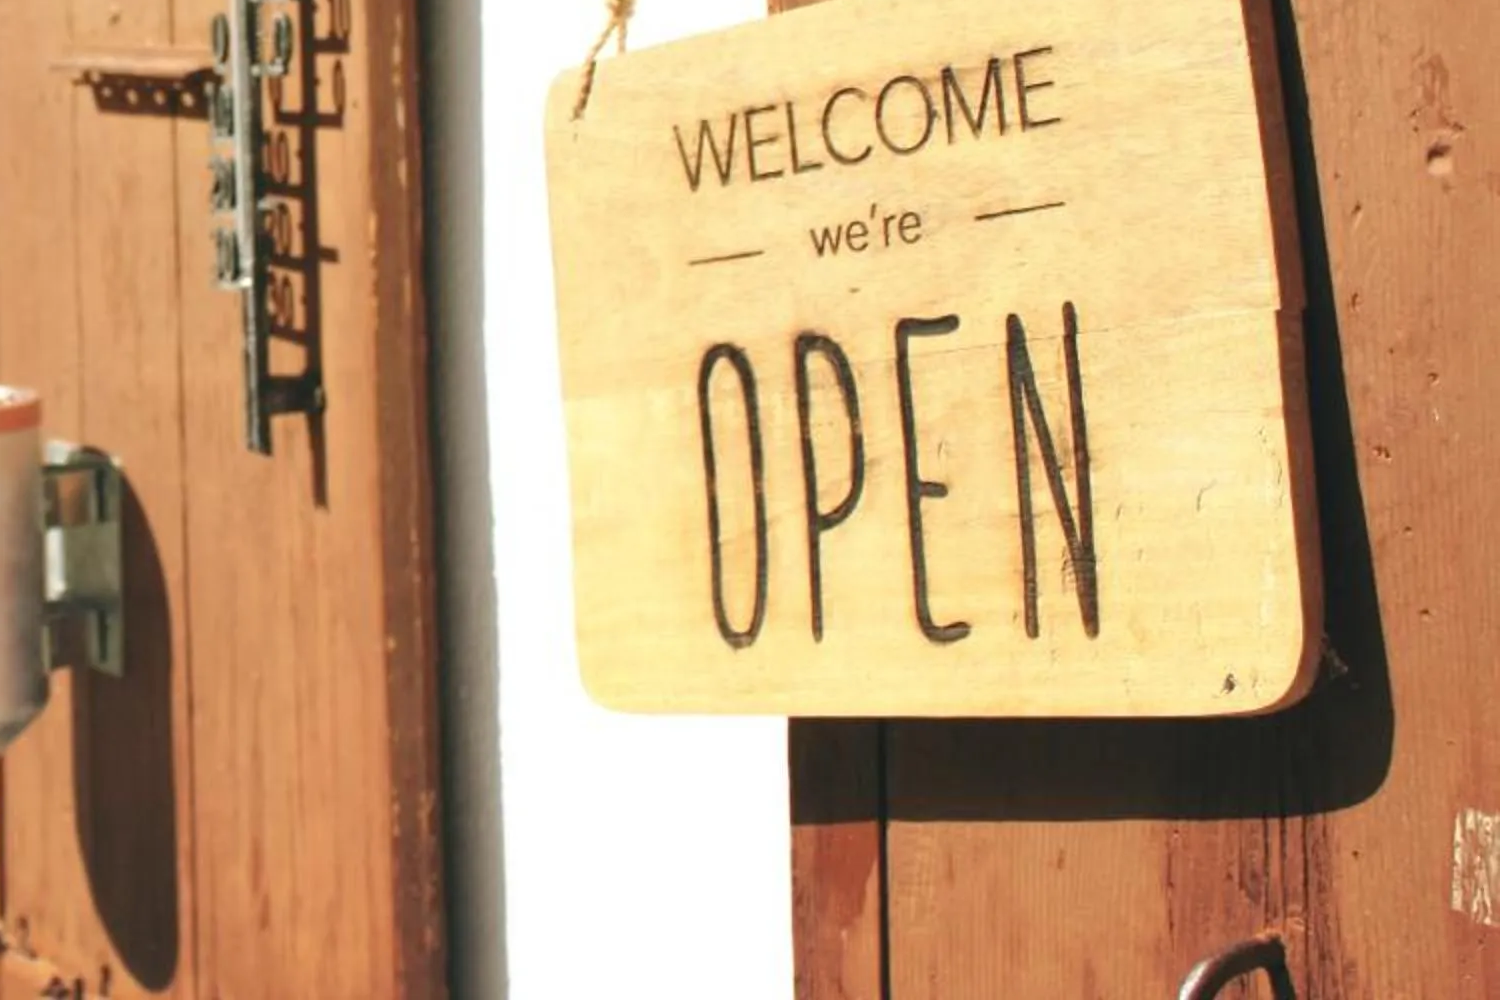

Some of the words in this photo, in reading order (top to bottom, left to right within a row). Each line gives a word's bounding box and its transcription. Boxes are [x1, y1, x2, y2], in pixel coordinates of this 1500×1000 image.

[673, 44, 1063, 193] WELCOME
[809, 203, 924, 258] we're
[698, 300, 1101, 650] OPEN
